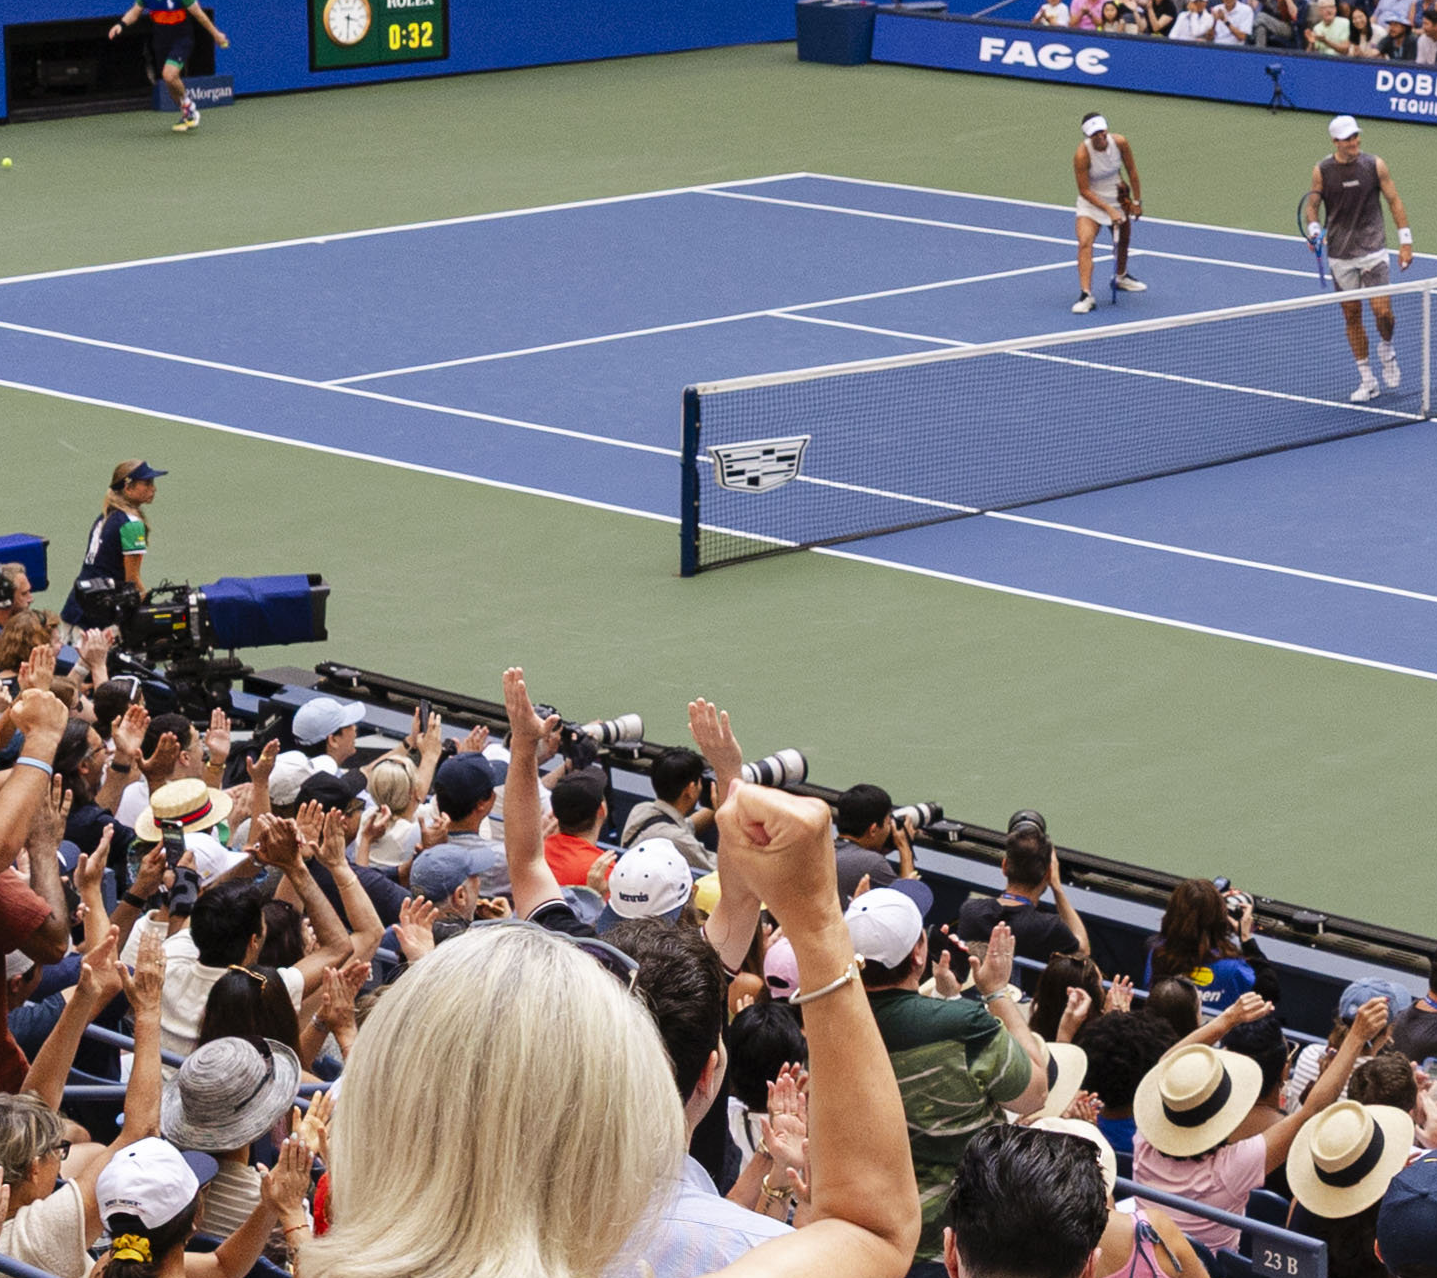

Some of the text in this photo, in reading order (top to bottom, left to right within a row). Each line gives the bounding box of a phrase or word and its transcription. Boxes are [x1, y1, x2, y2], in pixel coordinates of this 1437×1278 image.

[387, 20, 434, 52] 0:32
[182, 83, 234, 102] Morgan
[619, 891, 649, 903] tennis
[1263, 1250, 1298, 1274] 23 B
